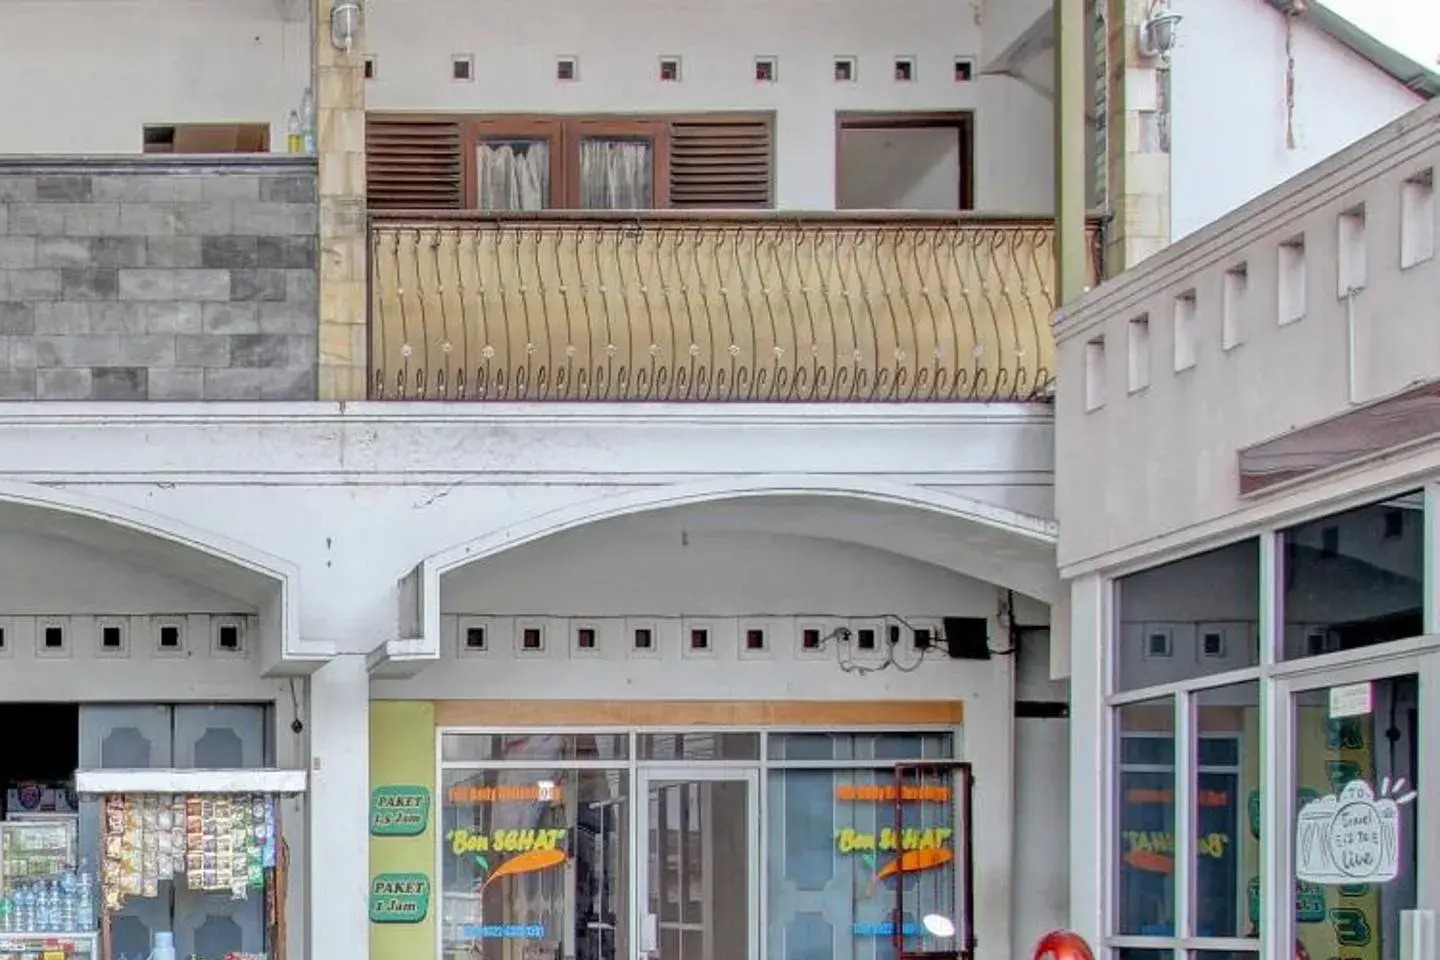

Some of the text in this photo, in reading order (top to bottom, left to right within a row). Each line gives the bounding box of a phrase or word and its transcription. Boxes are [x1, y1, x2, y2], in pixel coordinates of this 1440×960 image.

[379, 796, 424, 807] PAKET
[375, 882, 424, 893] PAKET
[388, 899, 417, 911] Jam
